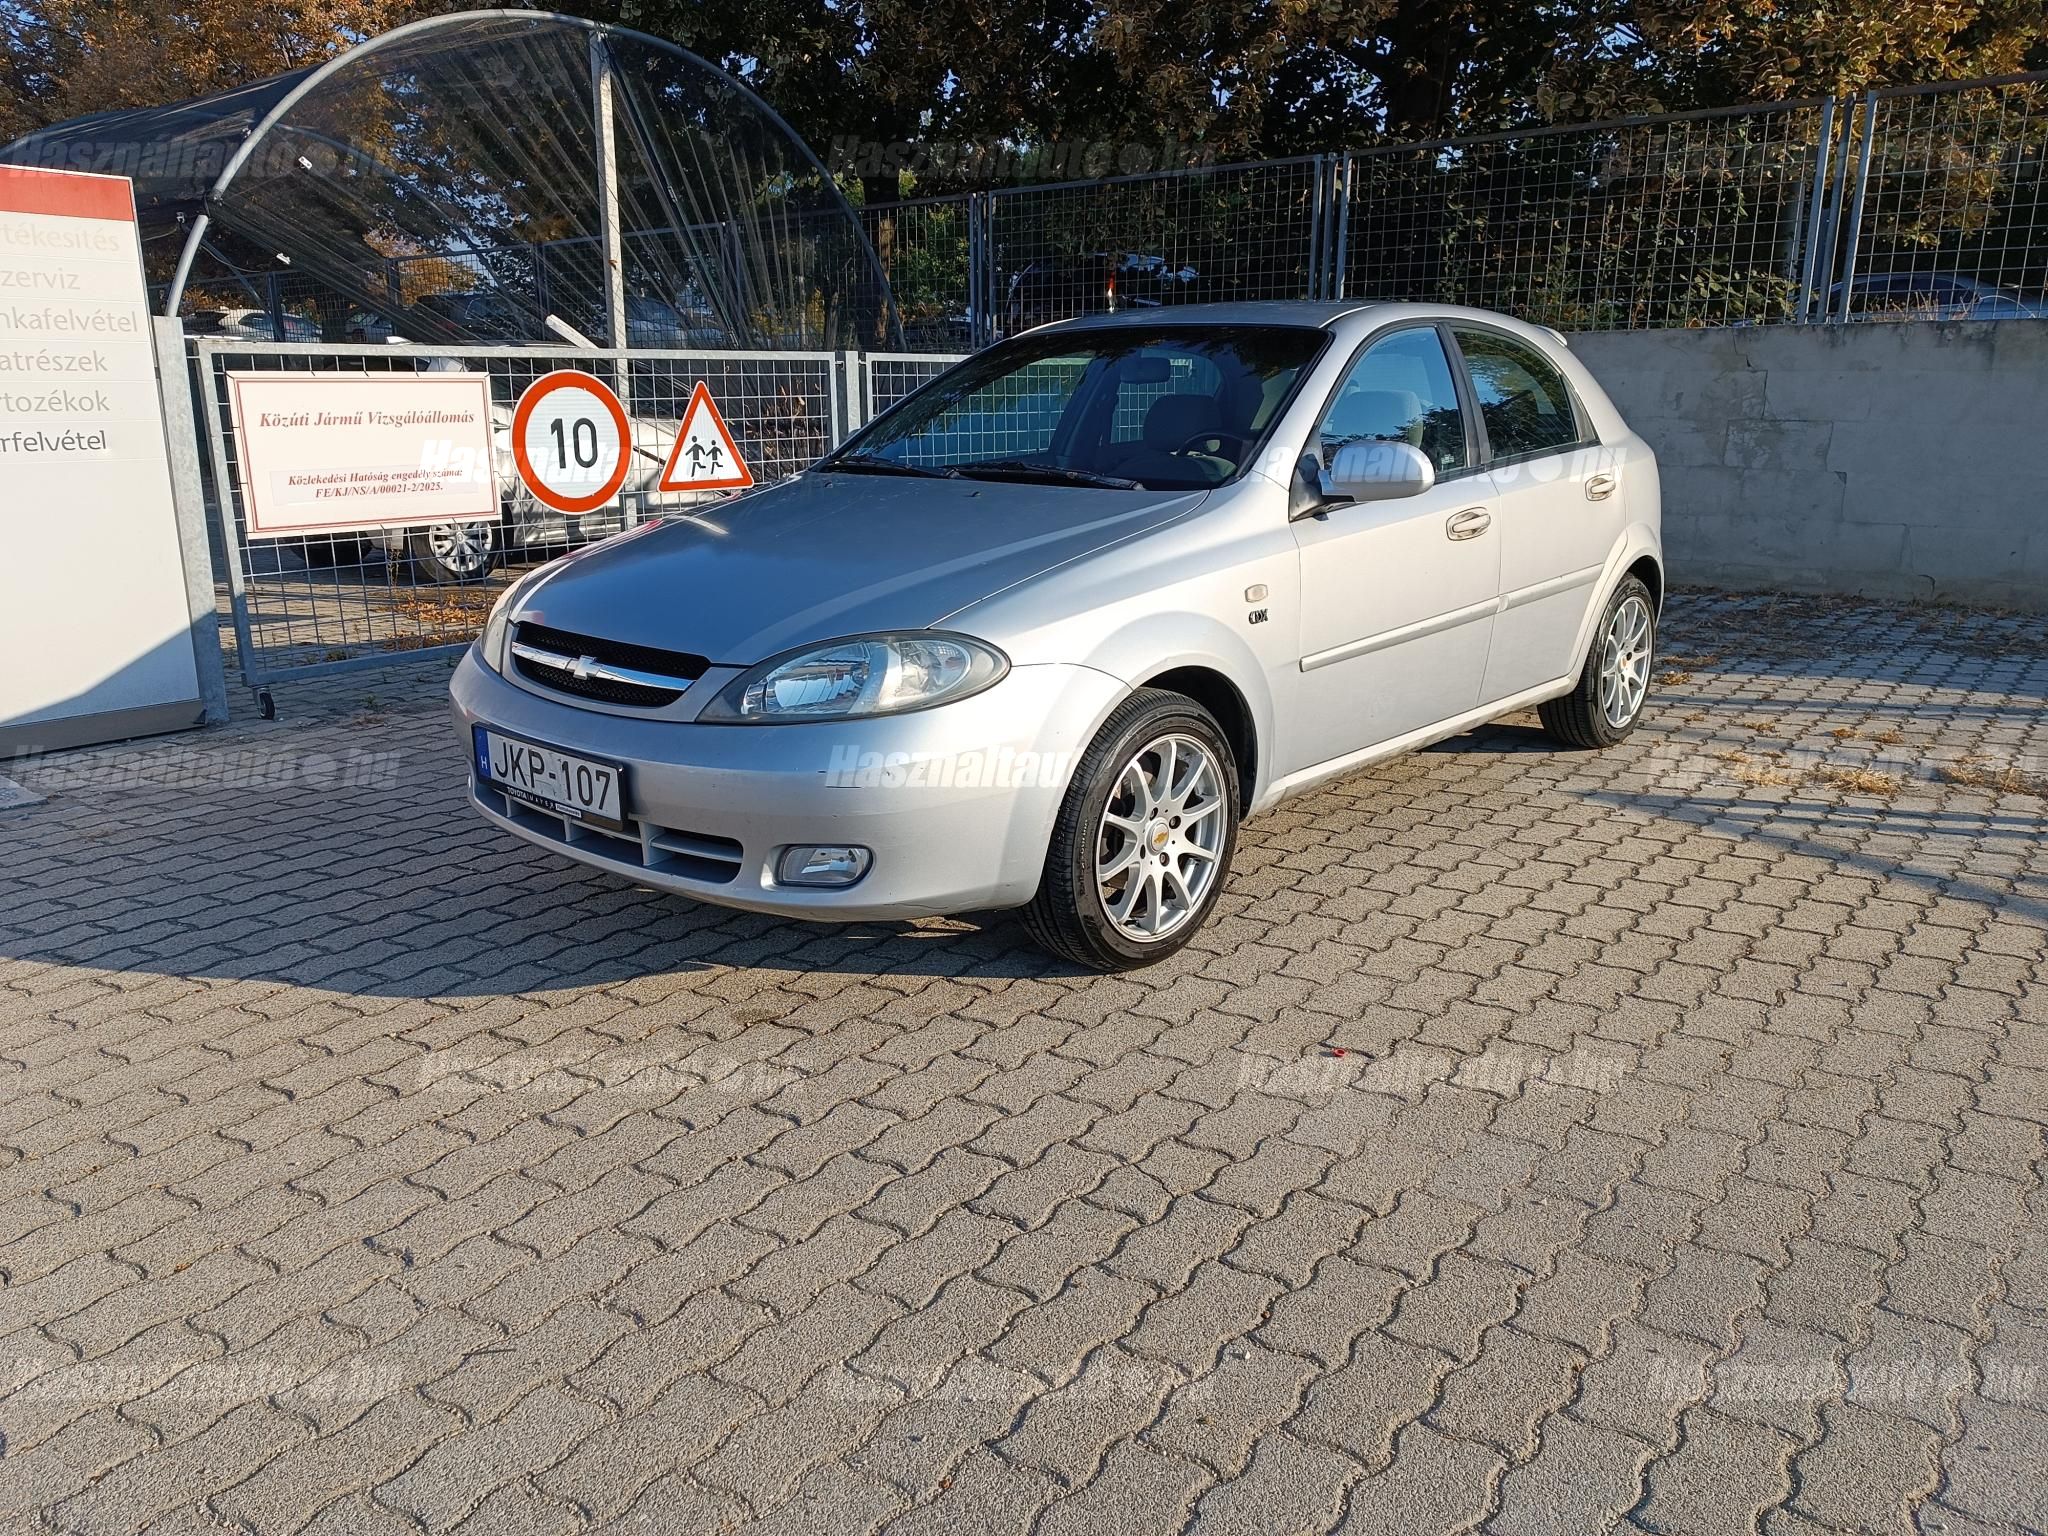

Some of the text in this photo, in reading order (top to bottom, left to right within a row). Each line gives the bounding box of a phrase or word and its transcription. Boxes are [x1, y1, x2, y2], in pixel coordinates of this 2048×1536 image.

[0, 390, 110, 412] tozékok
[260, 409, 475, 427] Közúti Jármű Vizsgálóállomás
[0, 430, 107, 453] rfelvétel
[550, 417, 598, 469] 10
[288, 469, 463, 486] Közlekedési Hatóság engedély száma:
[480, 754, 489, 770] H
[494, 741, 612, 811] JKP-107
[506, 786, 528, 801] TOYOTA
